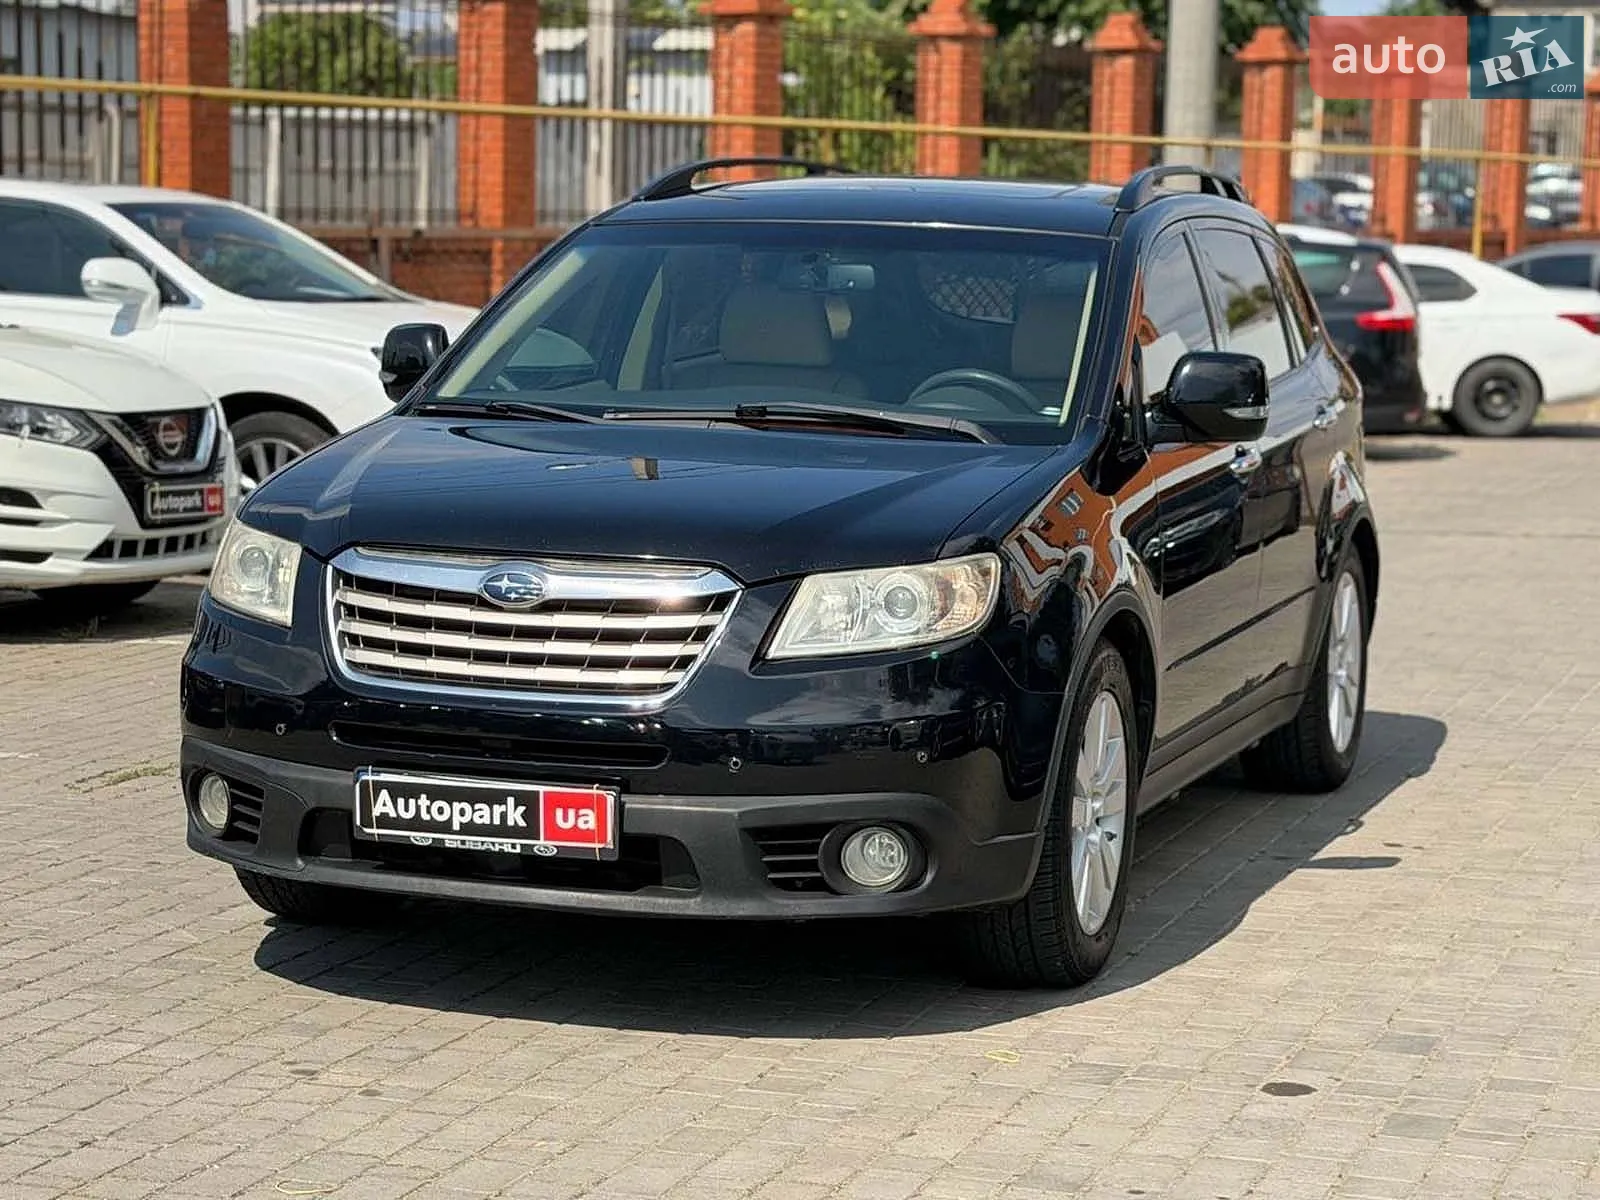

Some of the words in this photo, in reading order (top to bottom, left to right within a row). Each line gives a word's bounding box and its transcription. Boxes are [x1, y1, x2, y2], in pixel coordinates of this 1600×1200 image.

[152, 491, 202, 512] Autopark
[374, 789, 527, 831] Autopark
[555, 808, 596, 830] ua
